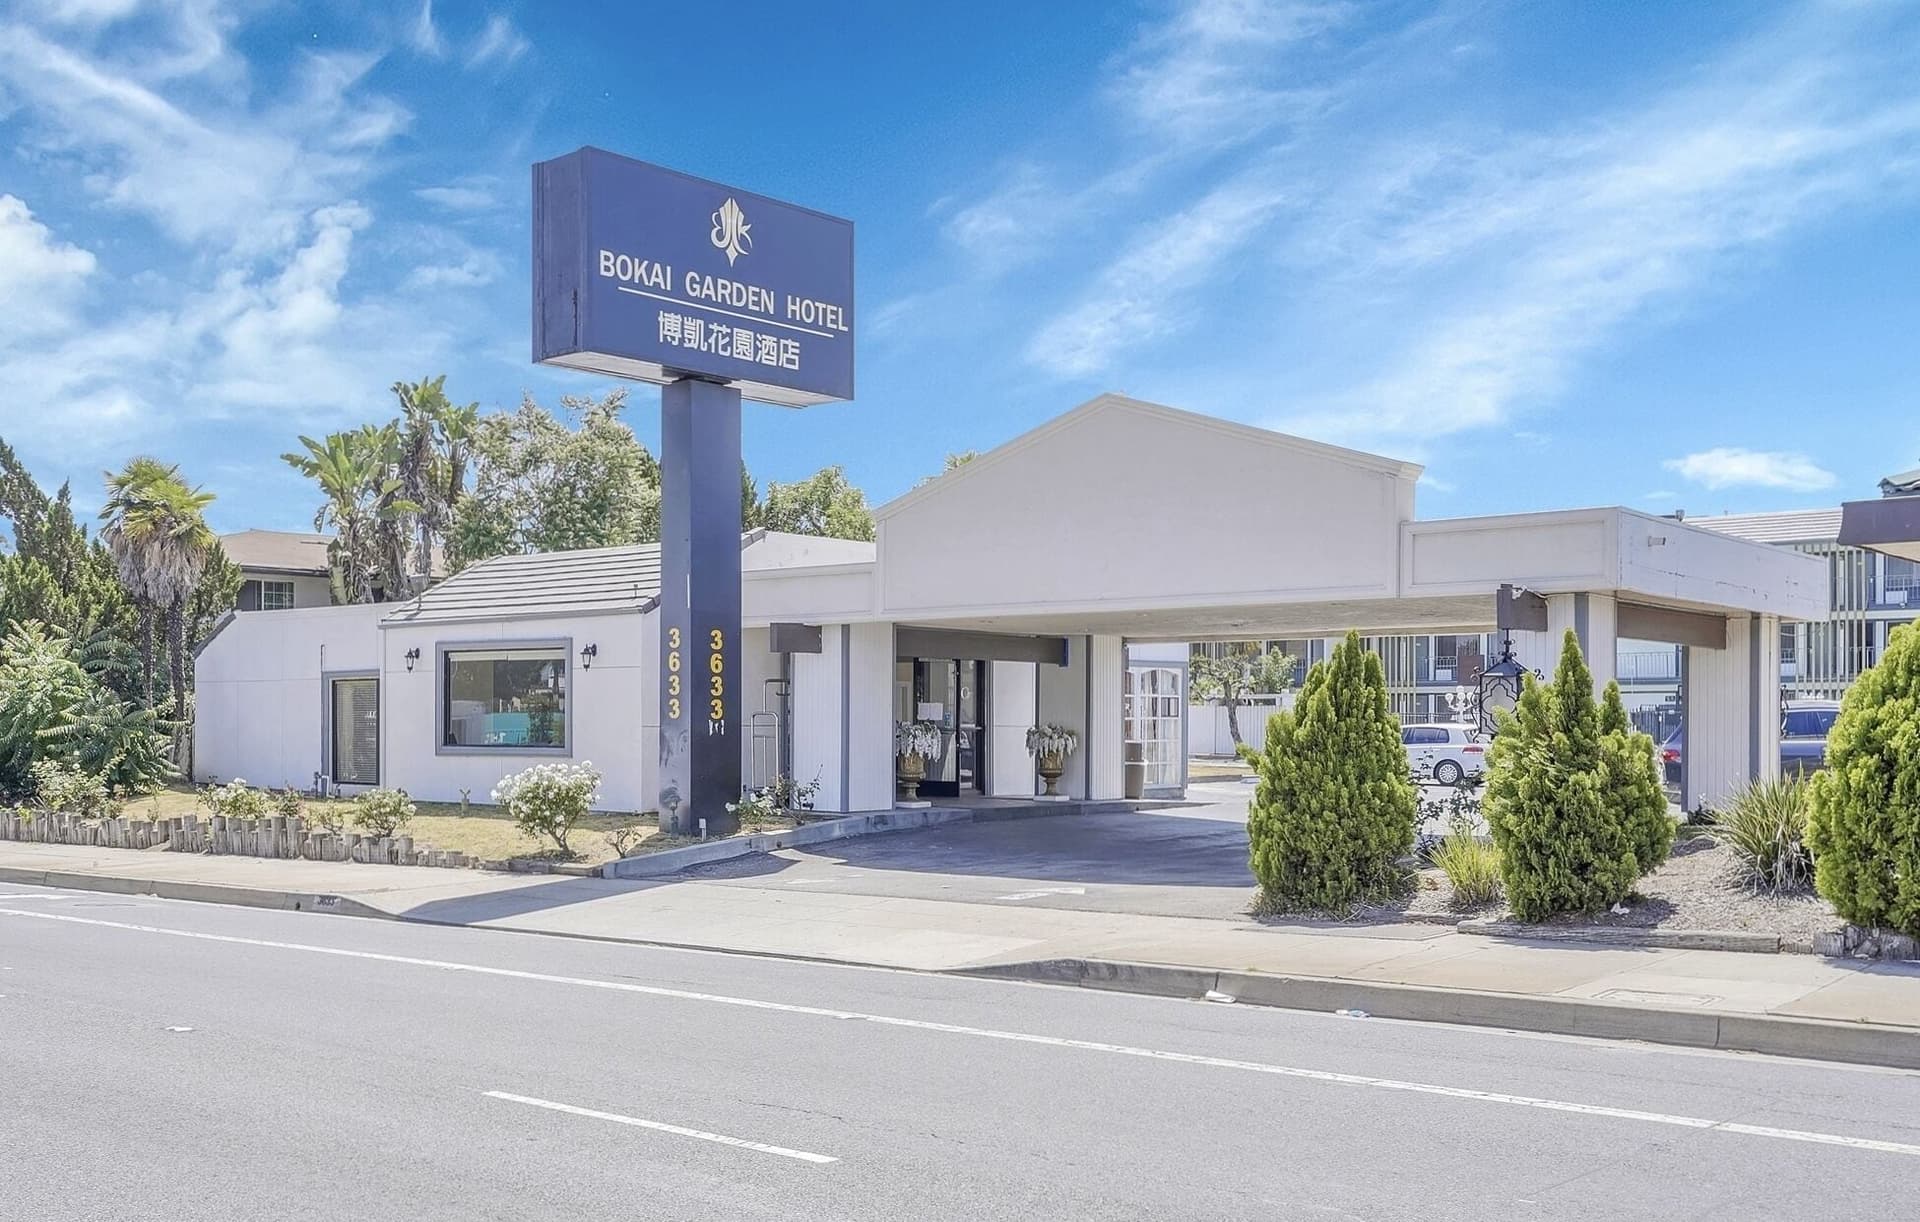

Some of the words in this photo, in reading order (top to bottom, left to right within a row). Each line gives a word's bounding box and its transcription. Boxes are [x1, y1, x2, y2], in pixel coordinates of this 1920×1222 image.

[600, 250, 672, 291] BOKAI
[685, 271, 774, 314] GARDEN
[787, 295, 848, 332] HOTEL
[658, 310, 800, 370] 博凱花園酒店
[668, 628, 681, 720] 3633
[710, 629, 723, 720] 3633
